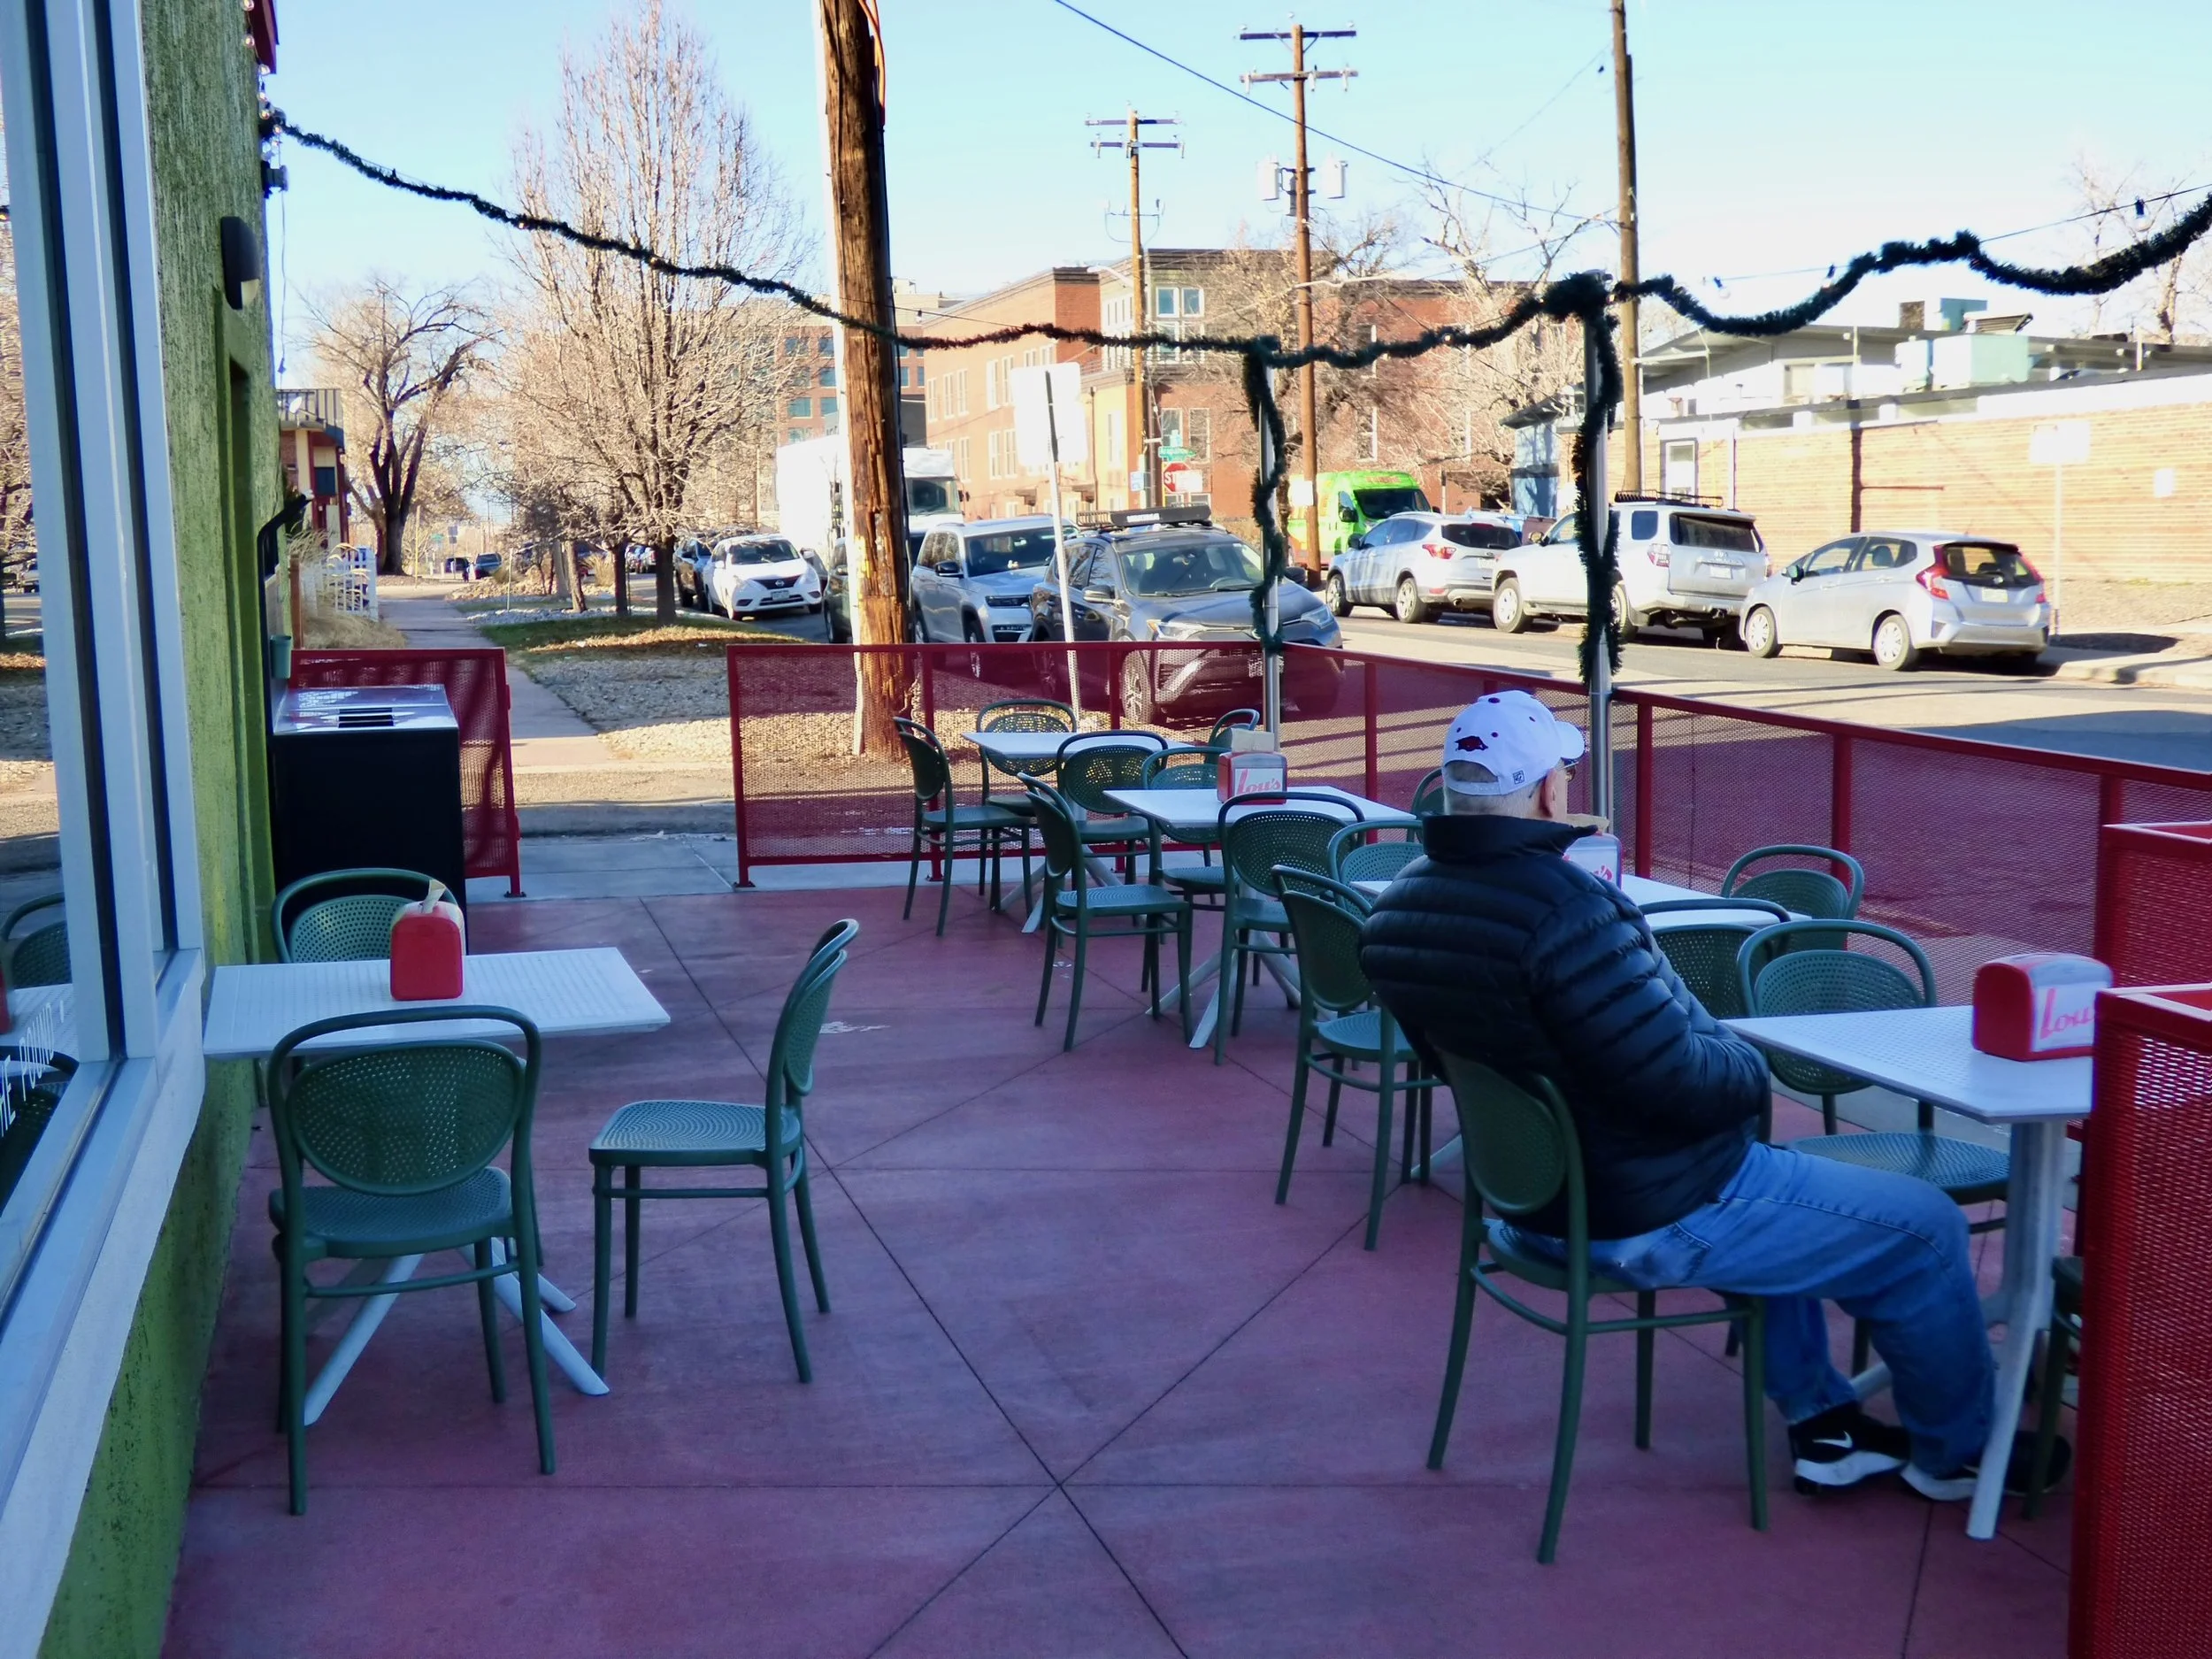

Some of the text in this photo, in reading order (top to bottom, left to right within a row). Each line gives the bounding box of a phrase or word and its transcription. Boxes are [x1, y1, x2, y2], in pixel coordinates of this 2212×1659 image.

[1164, 472, 1176, 484] ST
[1236, 768, 1281, 795] Lou's
[2039, 987, 2095, 1040] Lou
[0, 1002, 54, 1138] HE POUND
